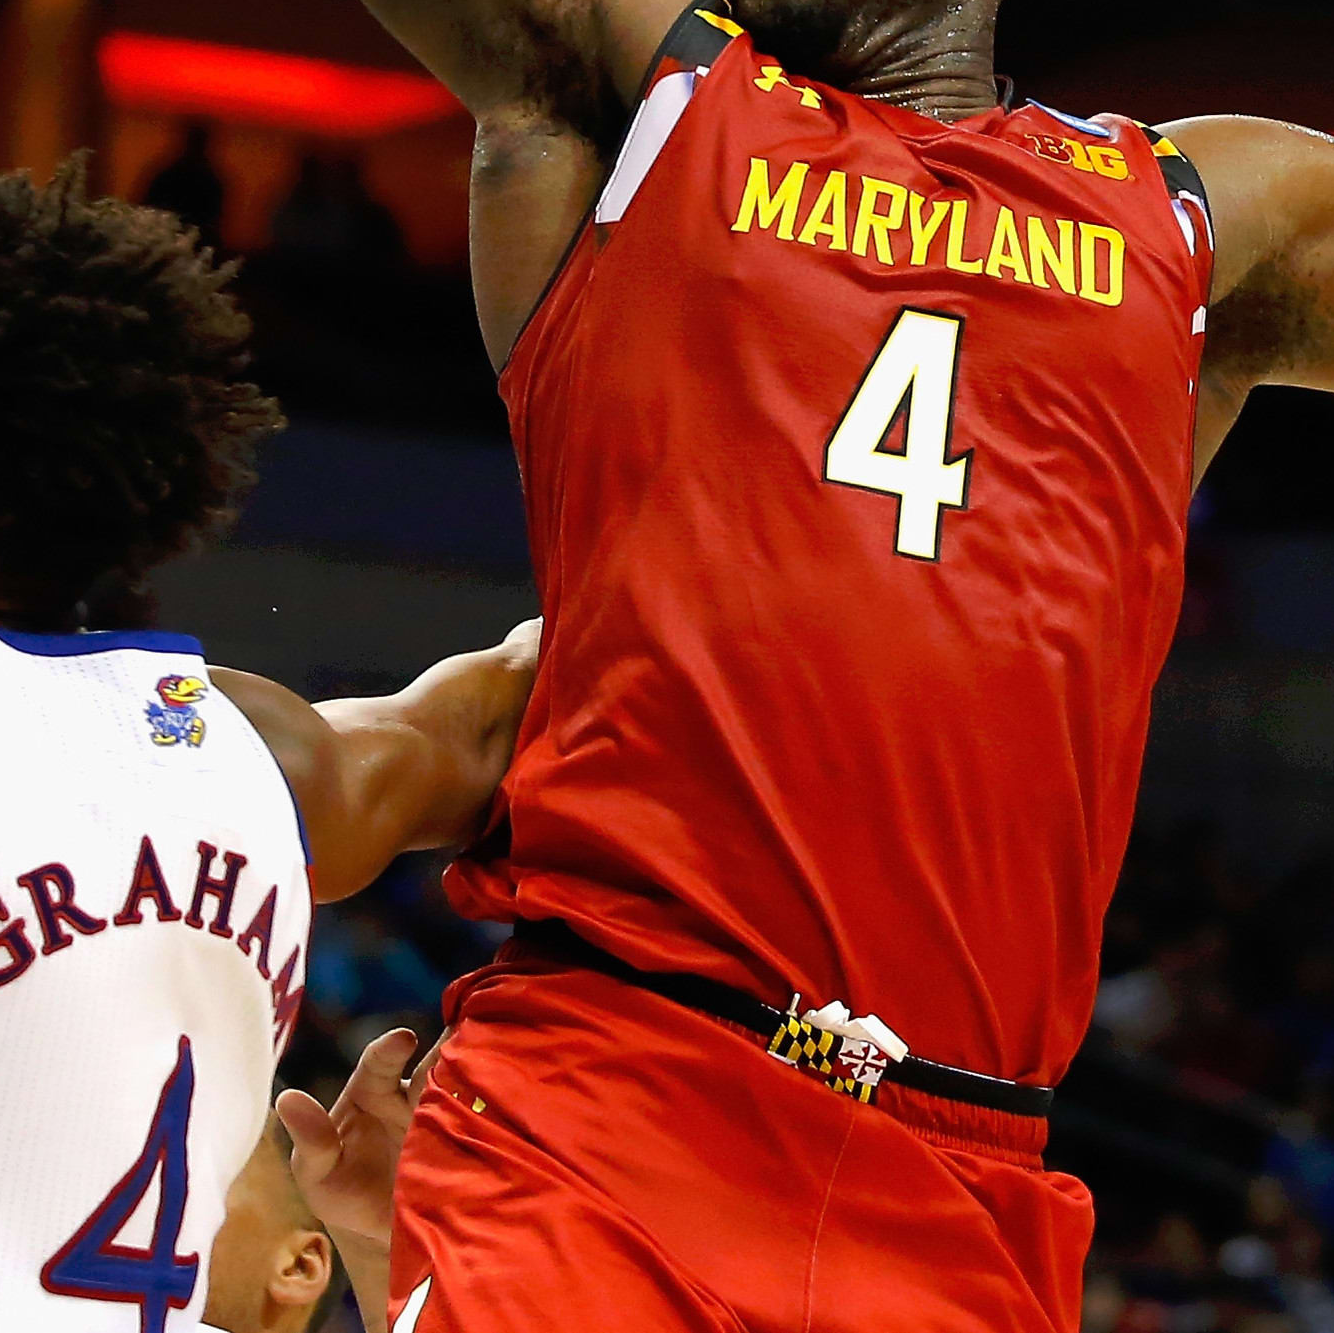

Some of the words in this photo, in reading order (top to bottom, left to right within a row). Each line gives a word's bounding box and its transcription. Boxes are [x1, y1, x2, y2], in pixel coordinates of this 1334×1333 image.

[730, 156, 1126, 308] MARYLAND
[823, 306, 975, 561] 4
[40, 1033, 200, 1333] 4
